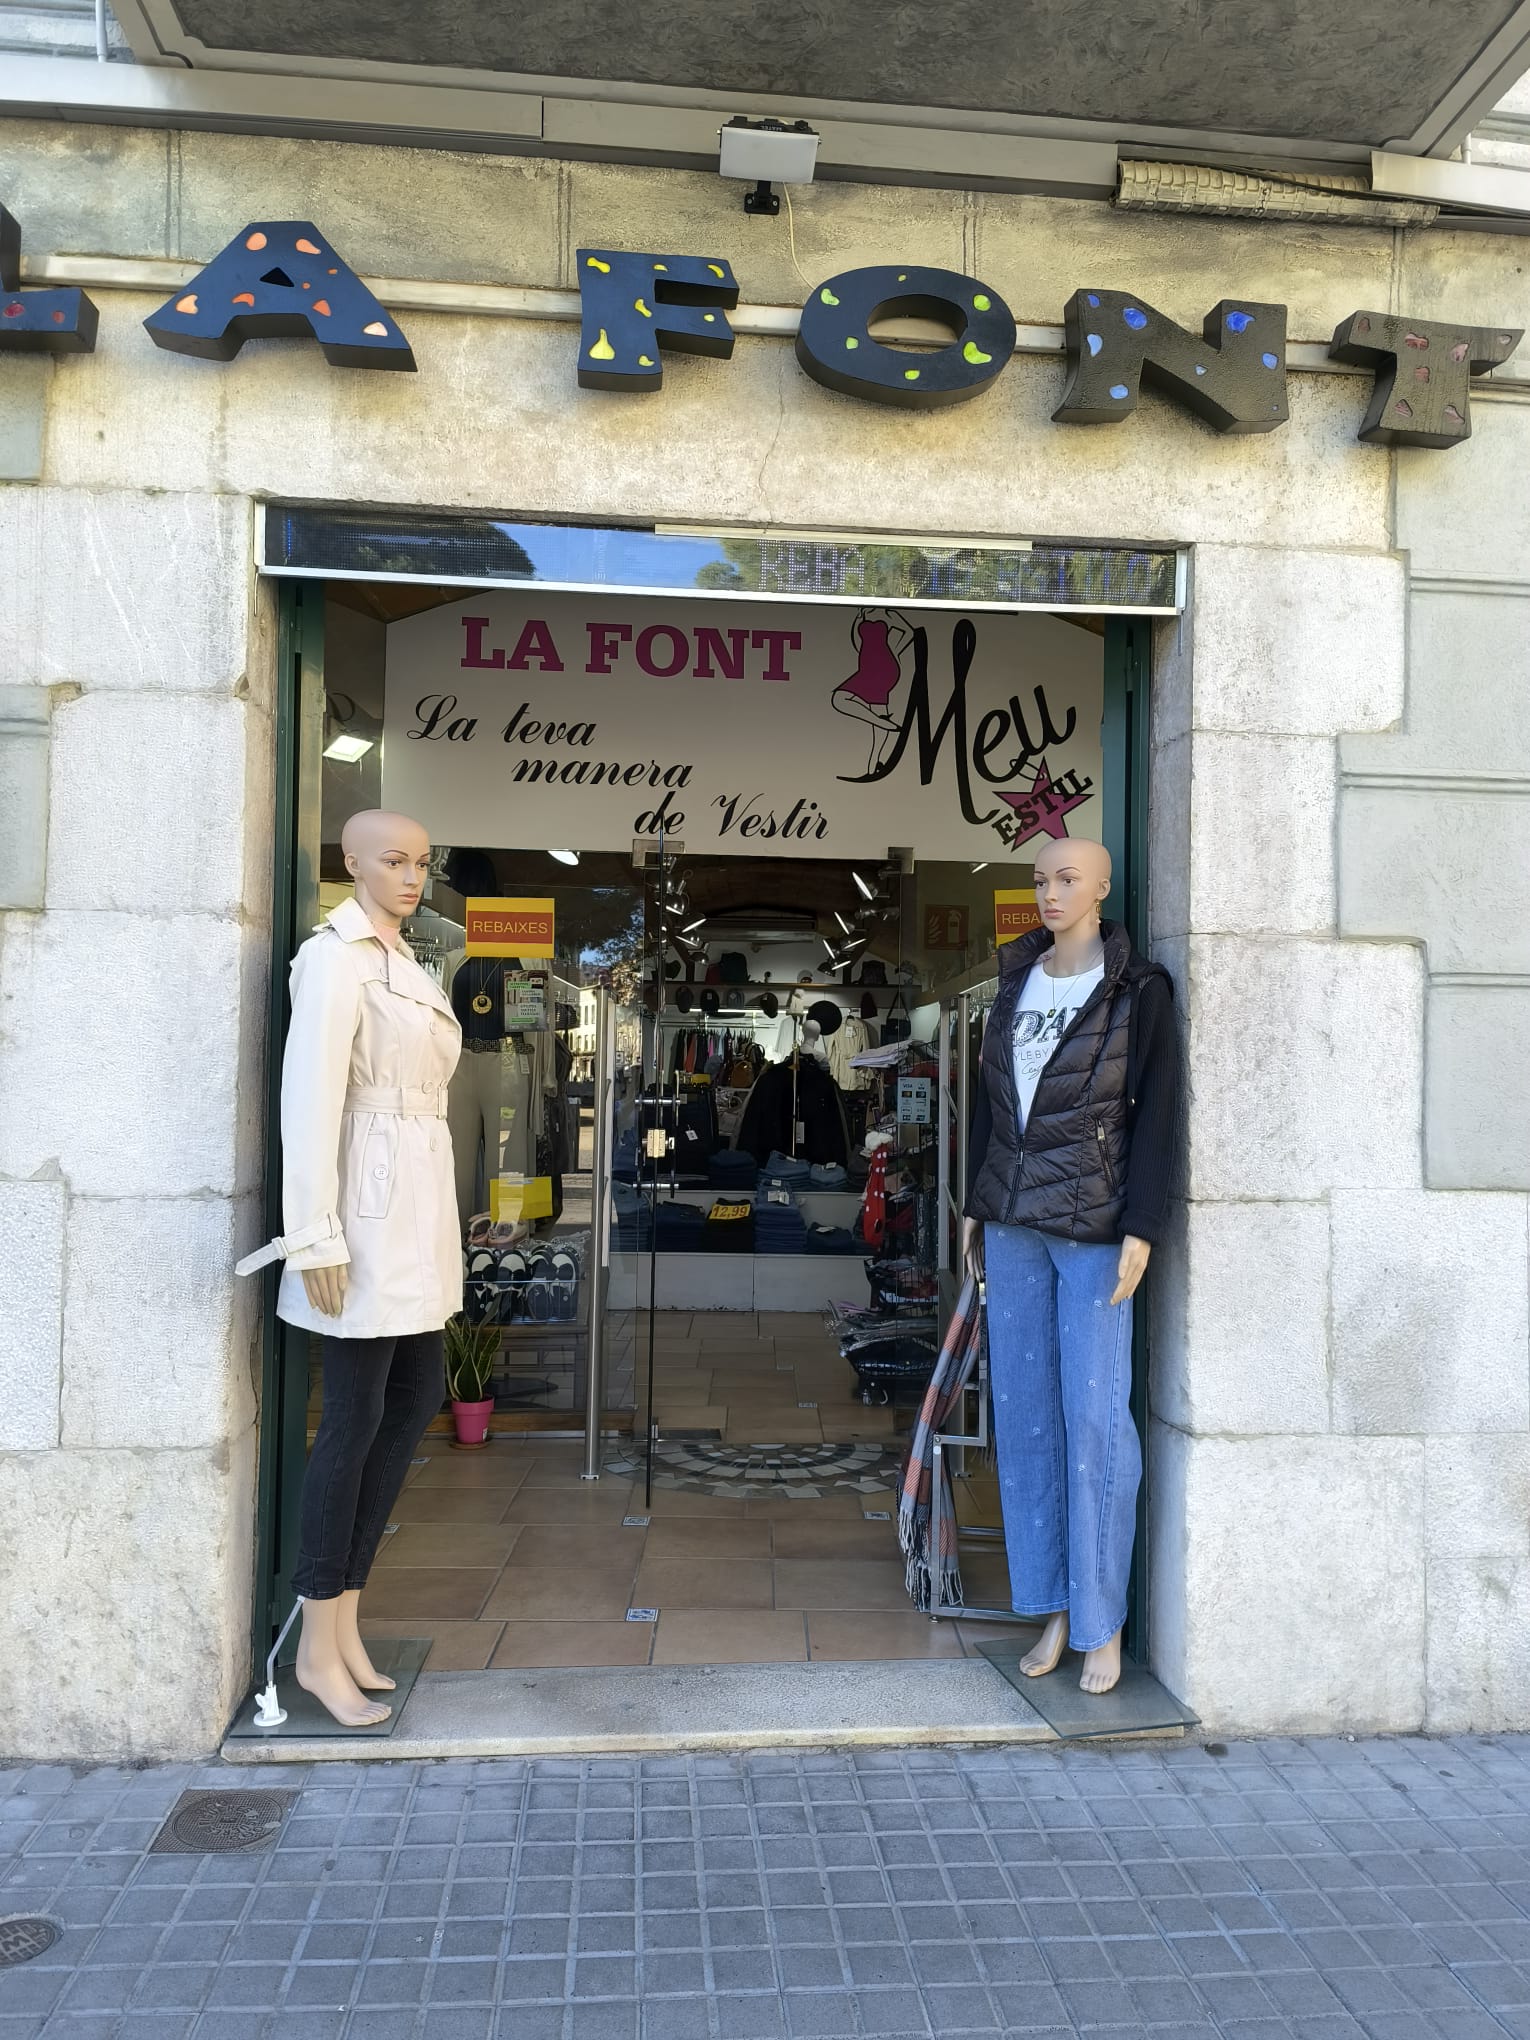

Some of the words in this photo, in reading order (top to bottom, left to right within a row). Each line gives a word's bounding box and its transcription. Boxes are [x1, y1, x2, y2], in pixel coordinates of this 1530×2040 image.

[0, 202, 417, 372] LA
[576, 249, 1525, 451] FONT
[460, 616, 565, 672] LA
[585, 622, 802, 681] FONT
[407, 694, 476, 742] La
[500, 702, 598, 746] teva
[836, 618, 1077, 825] Meu
[511, 754, 694, 788] manera
[634, 791, 685, 835] de
[711, 792, 829, 840] Vestir
[991, 767, 1095, 847] ESTIL
[472, 920, 549, 935] REBAIXES
[1001, 912, 1043, 925] REBA
[712, 1205, 748, 1218] 12,99
